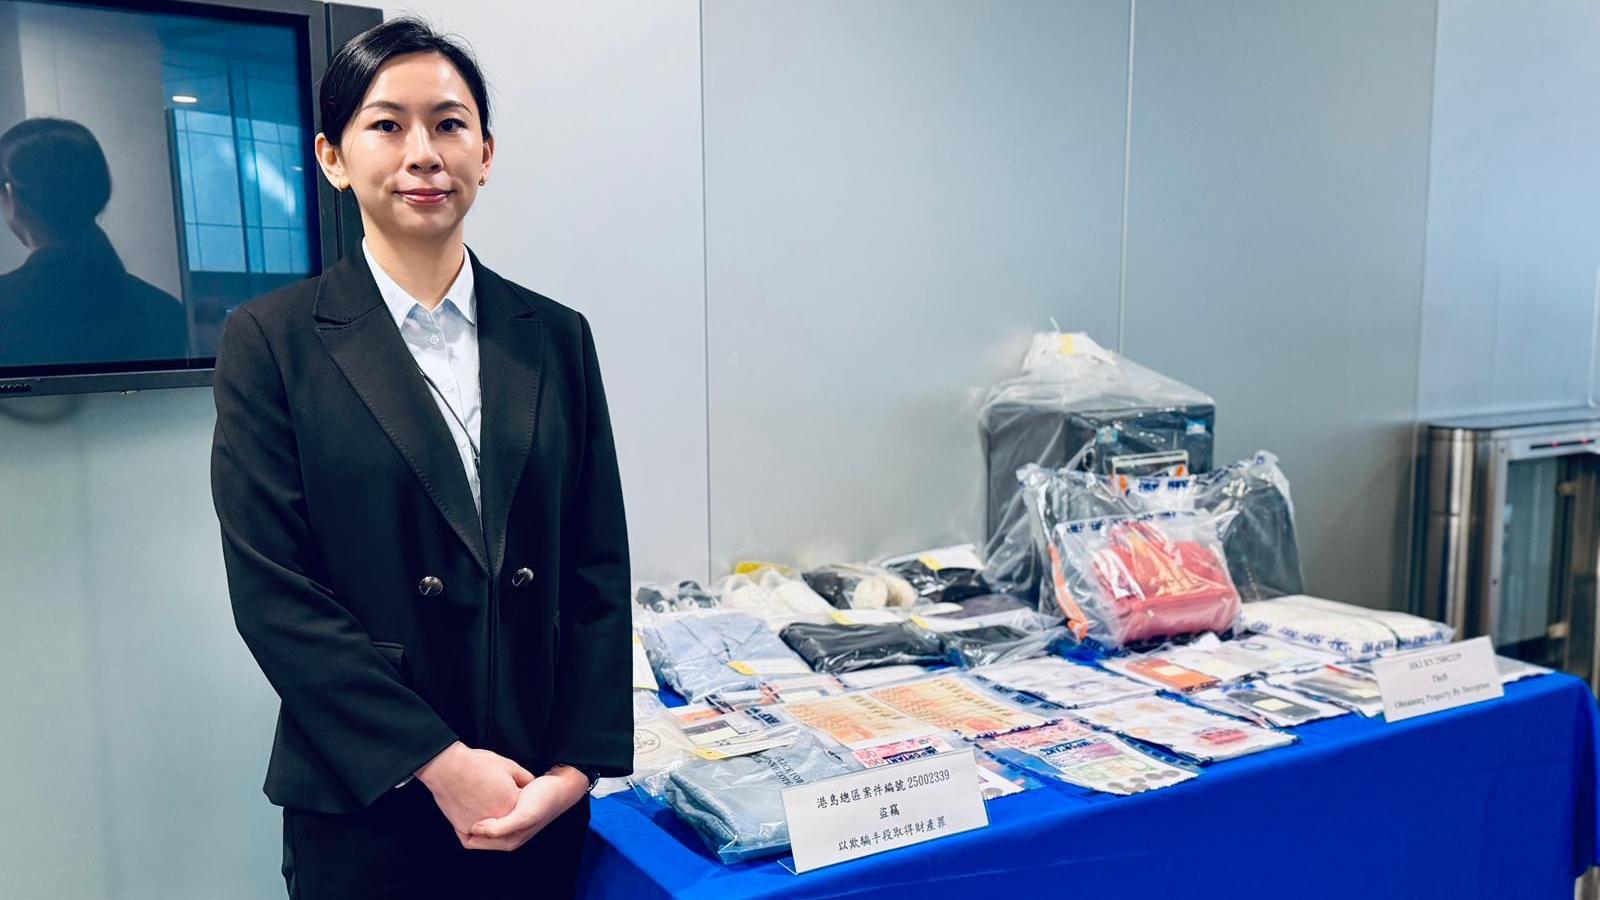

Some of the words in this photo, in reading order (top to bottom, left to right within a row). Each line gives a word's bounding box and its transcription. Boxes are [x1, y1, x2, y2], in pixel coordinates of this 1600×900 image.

[1425, 690, 1452, 703] Property
[1452, 687, 1461, 698] By
[1461, 683, 1490, 695] Deception
[816, 779, 906, 809] 港島總區案件編號
[907, 769, 950, 789] 25002339
[879, 803, 900, 820] 盜竊
[838, 816, 947, 851] 以欺騙手段取得財產罪
